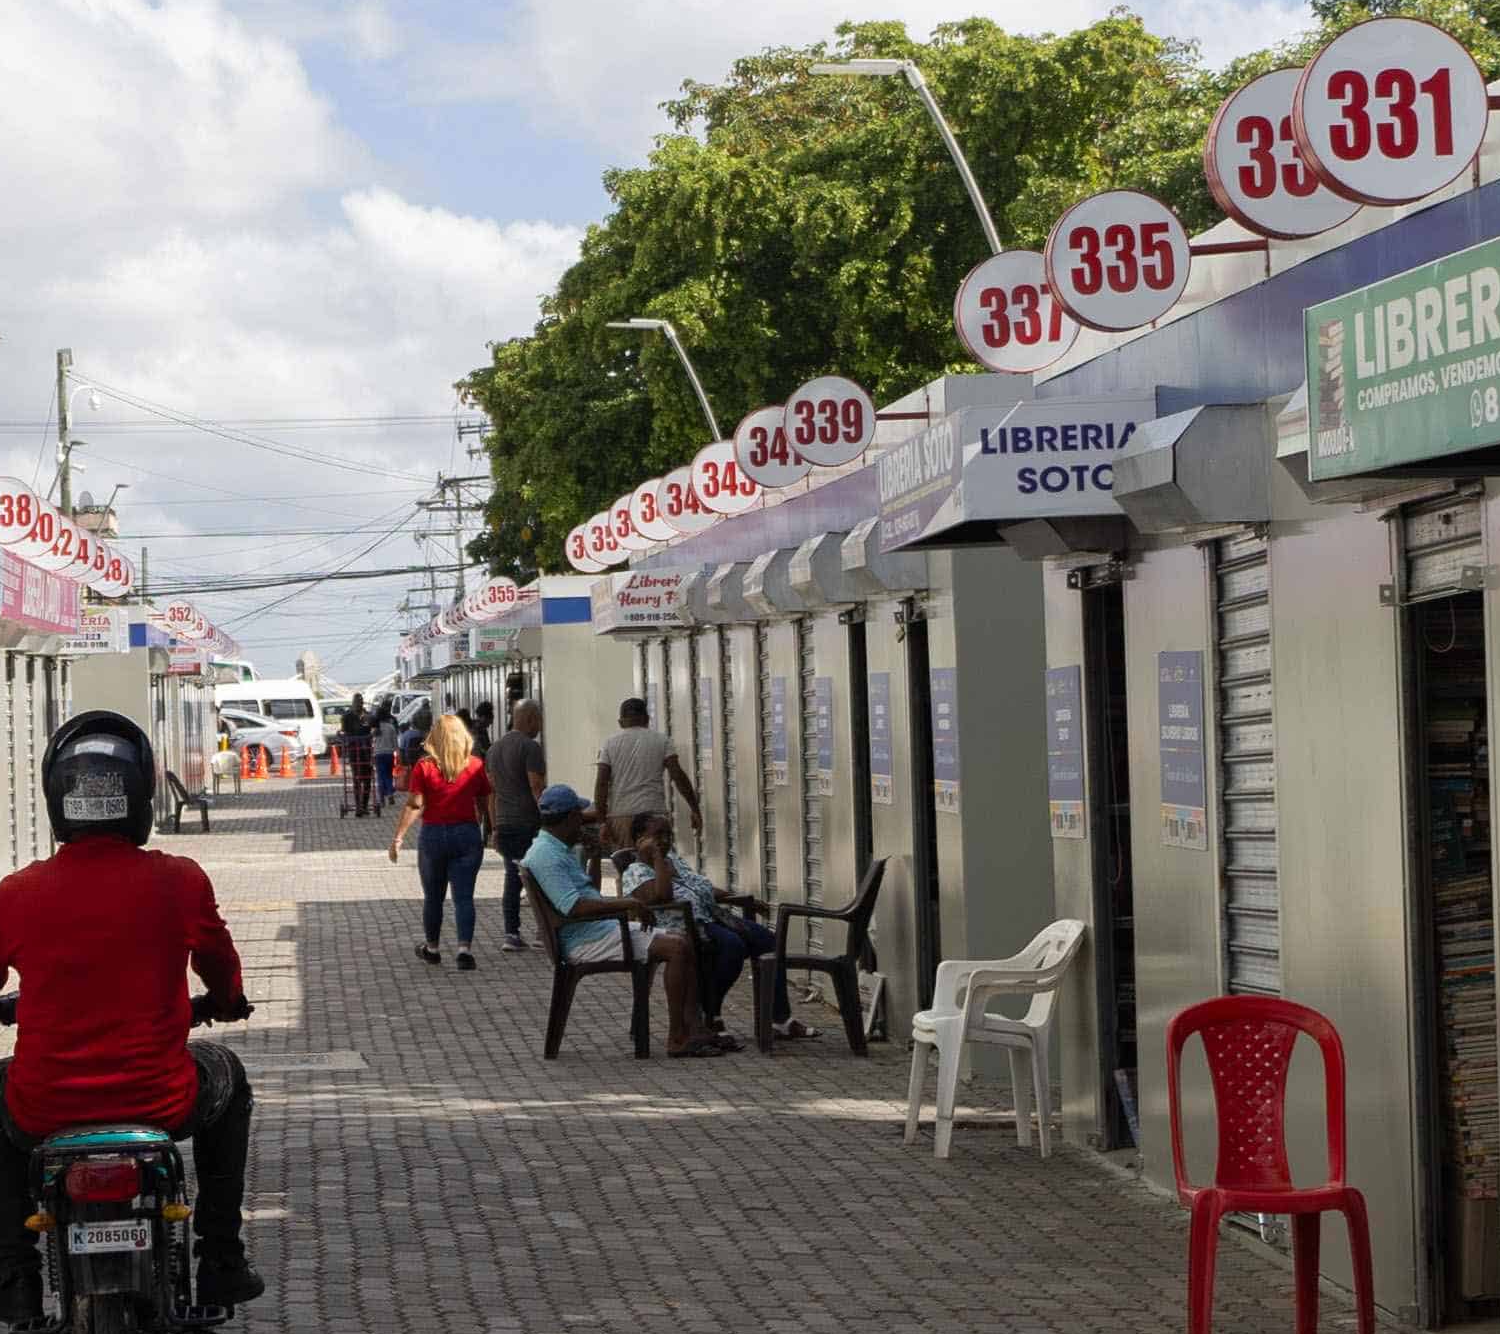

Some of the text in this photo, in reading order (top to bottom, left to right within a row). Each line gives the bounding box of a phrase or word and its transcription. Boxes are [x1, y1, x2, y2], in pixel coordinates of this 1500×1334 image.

[1326, 67, 1453, 161] 331
[1236, 115, 1318, 198] 33
[1068, 222, 1175, 296] 335
[749, 425, 801, 468] 34
[793, 398, 863, 445] 339
[879, 438, 922, 503] LIBRERIA
[922, 421, 954, 479] SOTO
[168, 606, 191, 623] 352
[487, 585, 515, 604] 355
